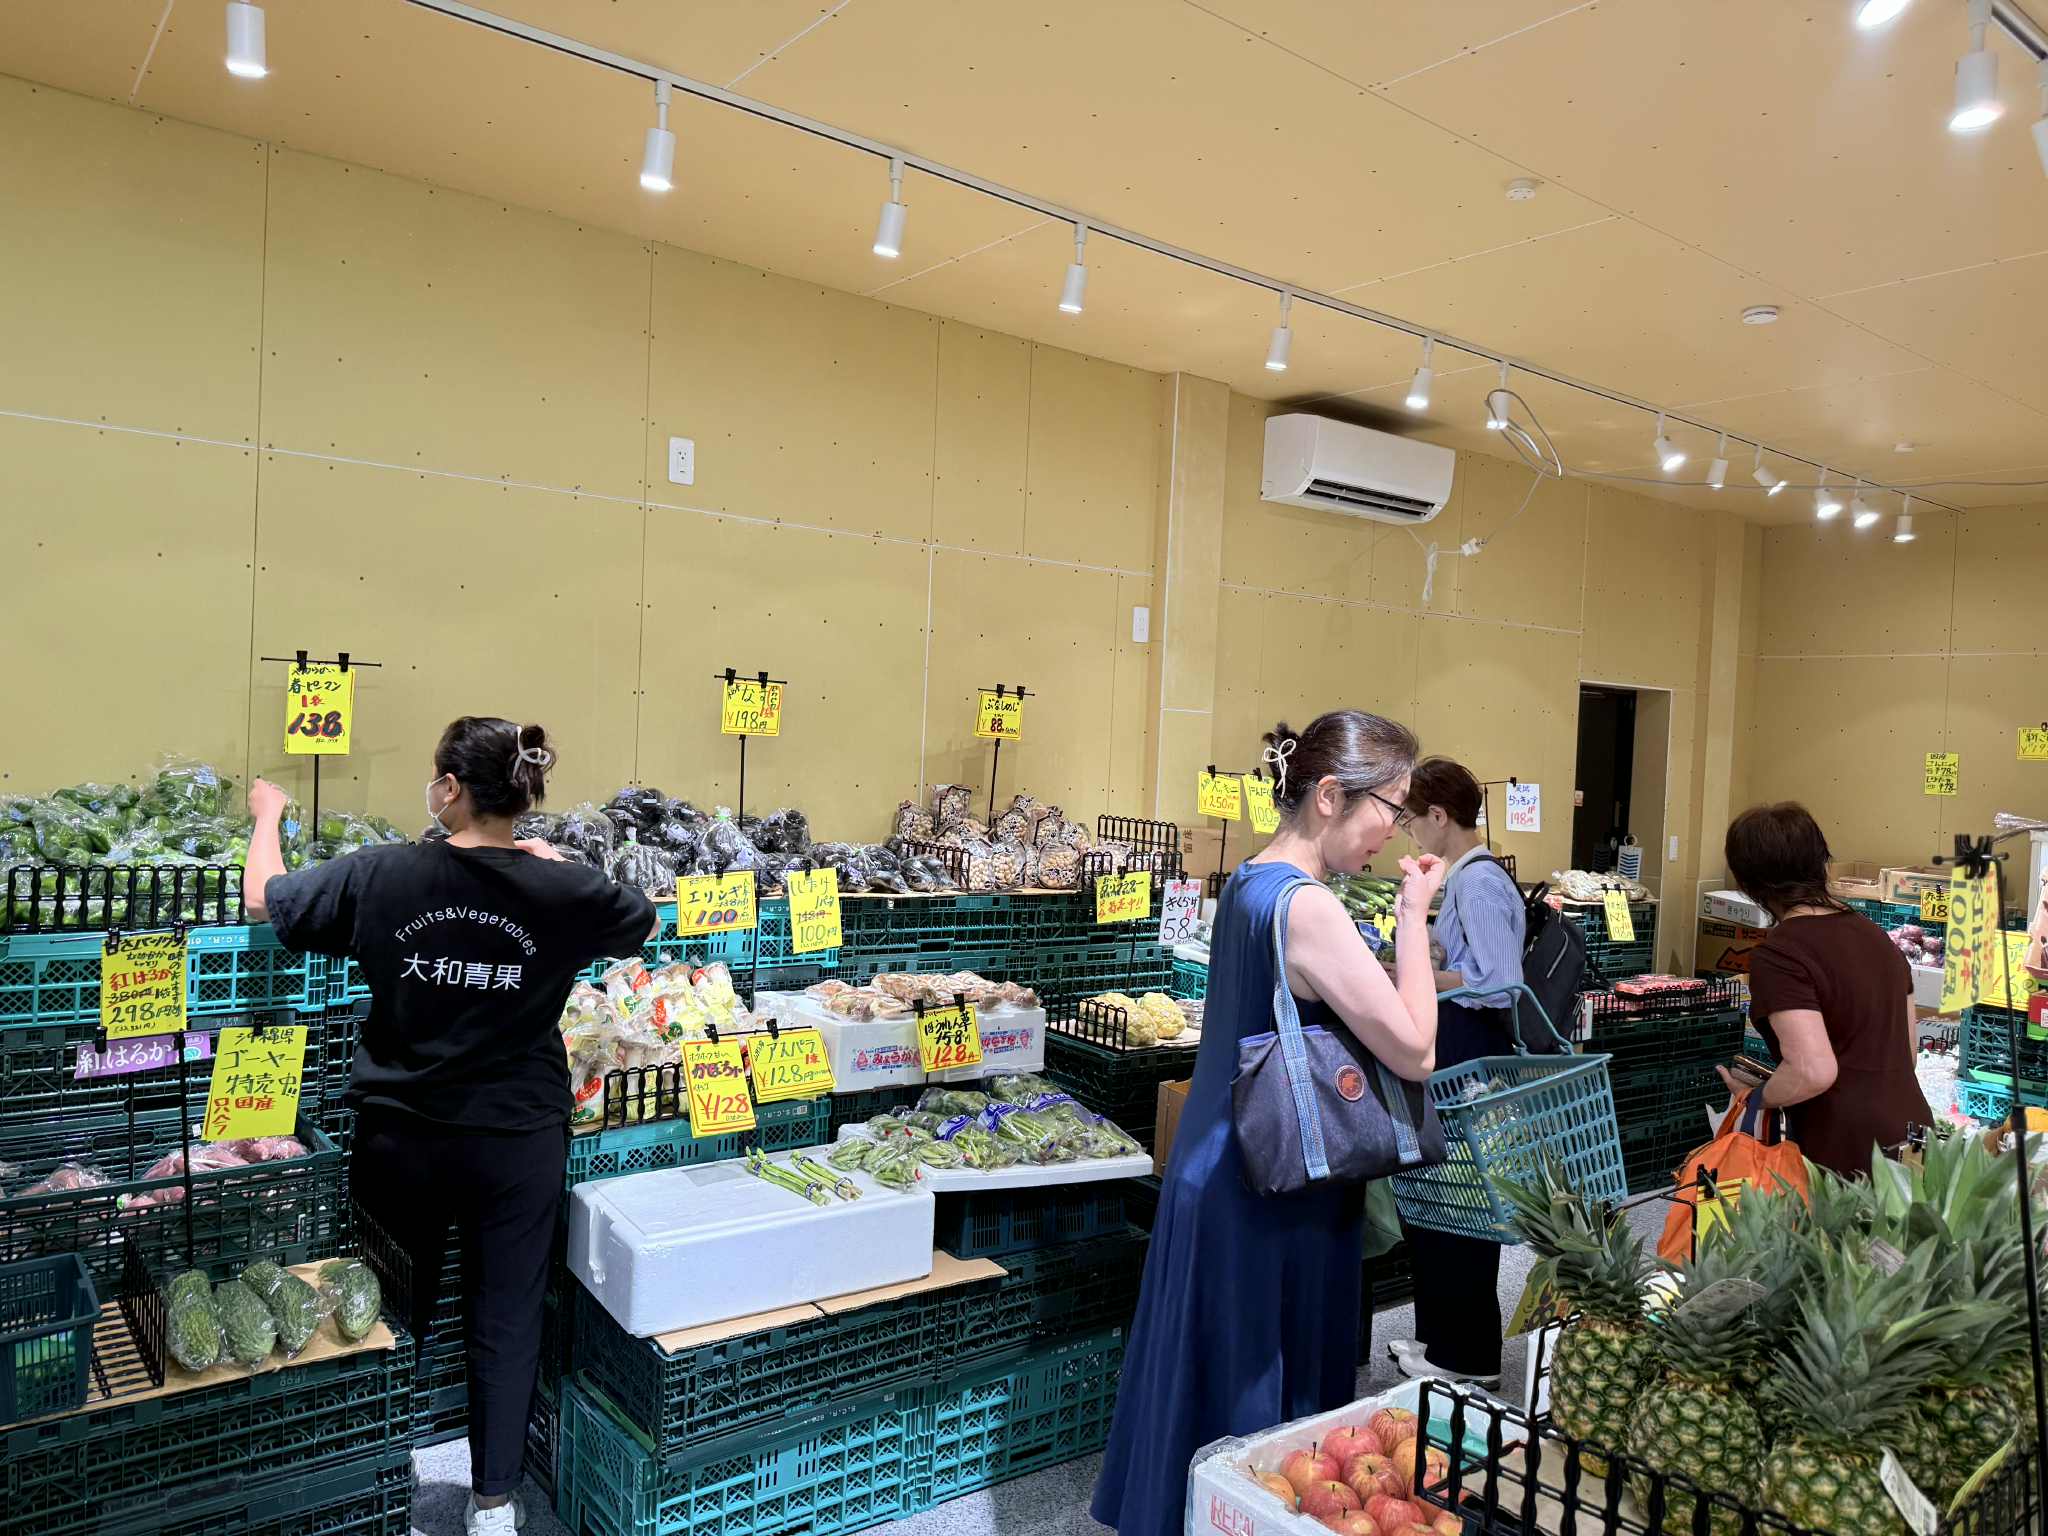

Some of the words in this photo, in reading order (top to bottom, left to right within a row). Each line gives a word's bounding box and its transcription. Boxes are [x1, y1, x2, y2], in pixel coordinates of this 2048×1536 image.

[985, 698, 1020, 712] ぶなしめじ
[687, 884, 742, 904] エリンギ
[395, 905, 537, 955] Fruits&Vegetables
[400, 952, 523, 991] 大和青果
[78, 1040, 172, 1074] 紅はるか
[220, 1049, 297, 1071] ゴーヤー
[766, 1038, 816, 1064] アスパラ
[691, 1060, 743, 1080] かぼちゃ
[225, 1072, 298, 1098] 特売中!!
[234, 1095, 275, 1112] 国産
